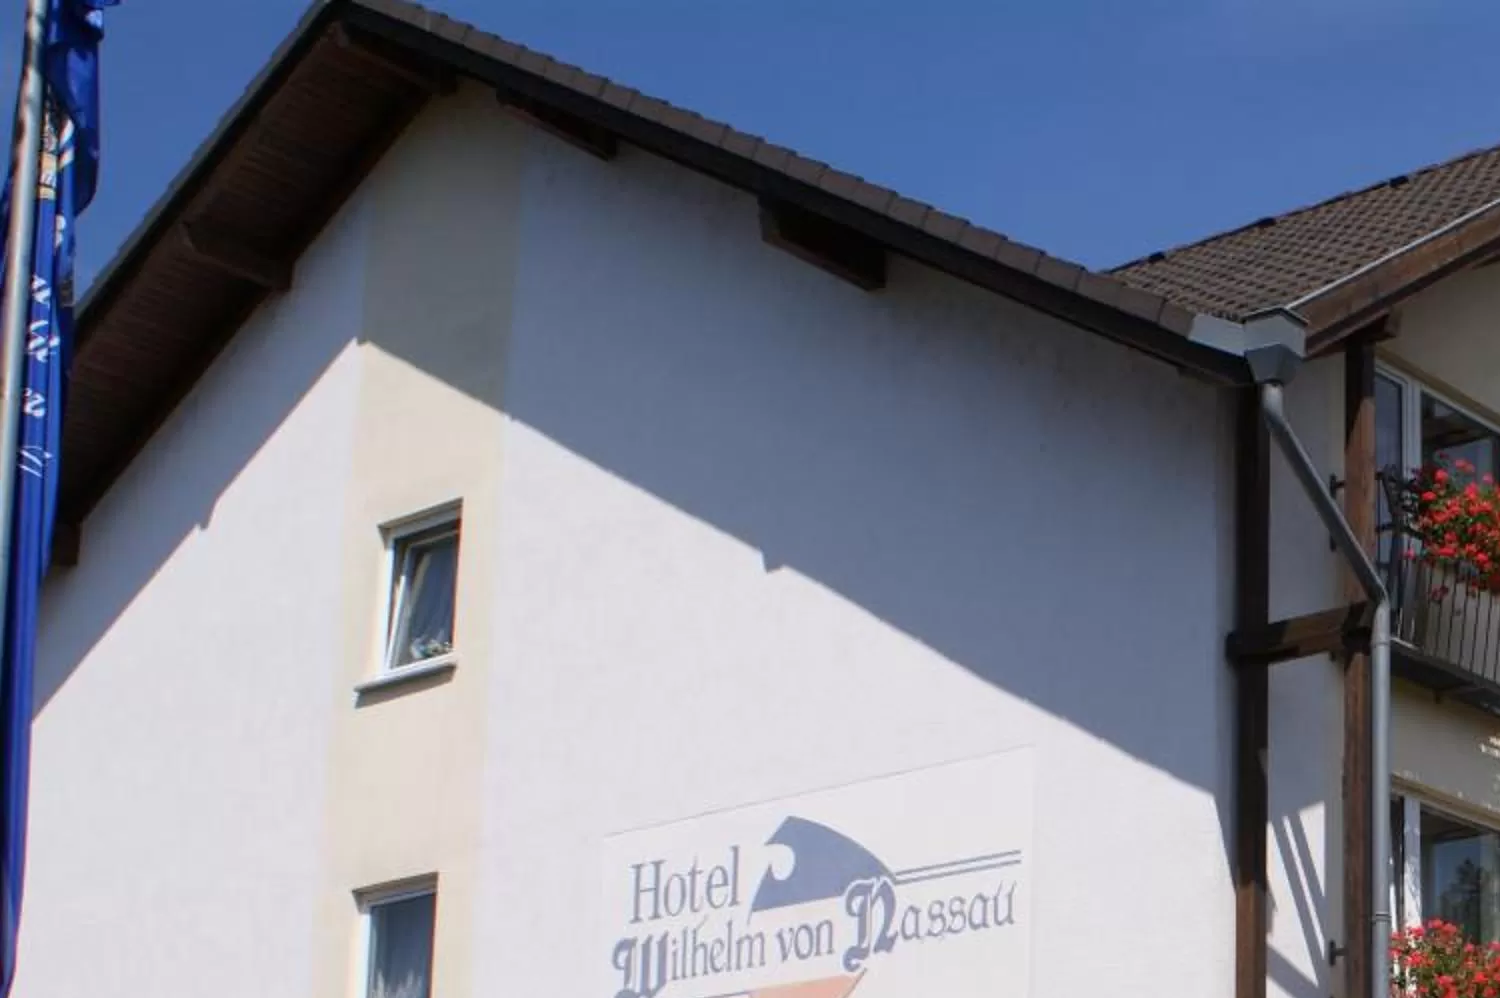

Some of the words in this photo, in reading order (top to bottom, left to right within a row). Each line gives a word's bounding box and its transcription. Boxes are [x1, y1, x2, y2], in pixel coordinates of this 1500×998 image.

[630, 845, 740, 923] Hotel
[776, 919, 835, 962] von
[843, 878, 1017, 972] Nassau
